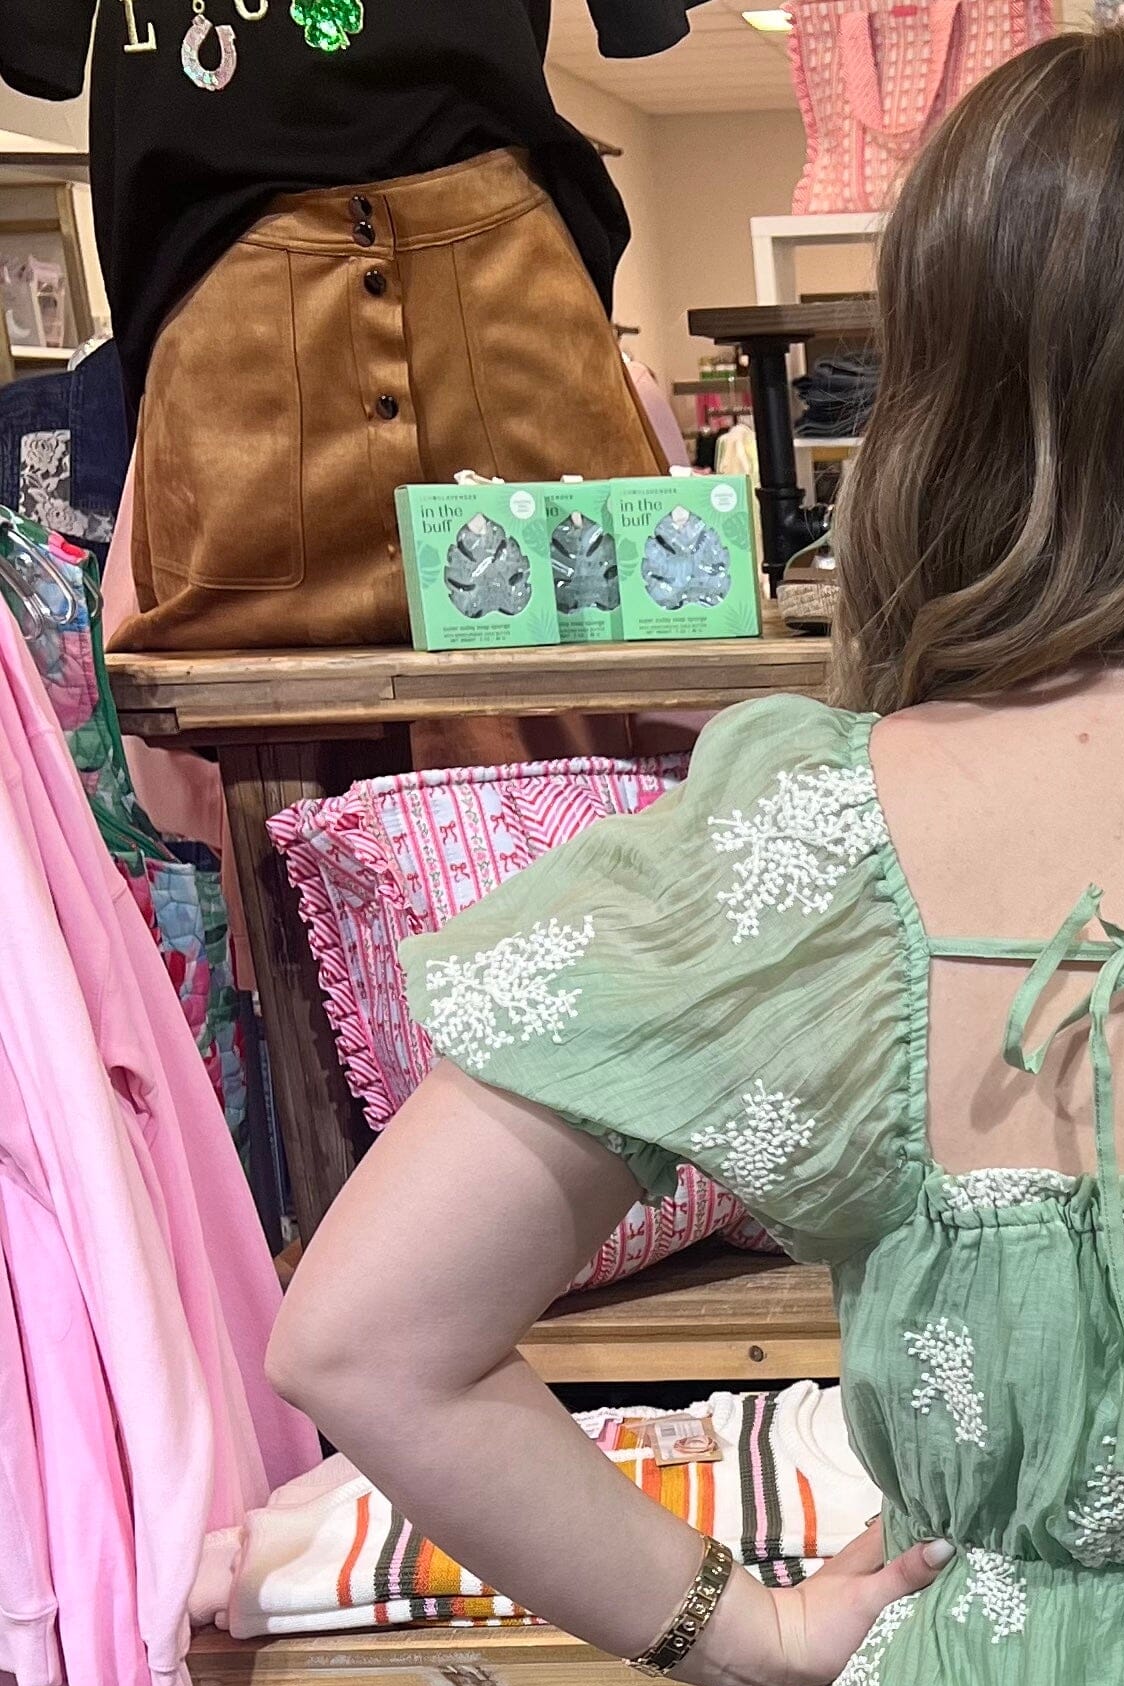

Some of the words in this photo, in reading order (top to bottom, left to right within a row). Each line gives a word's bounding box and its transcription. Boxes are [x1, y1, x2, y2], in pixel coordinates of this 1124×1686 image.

[421, 505, 434, 518] in
[438, 504, 463, 518] the
[620, 499, 633, 512] in
[638, 498, 662, 511] the
[422, 519, 452, 534] buff
[621, 513, 651, 527] buff
